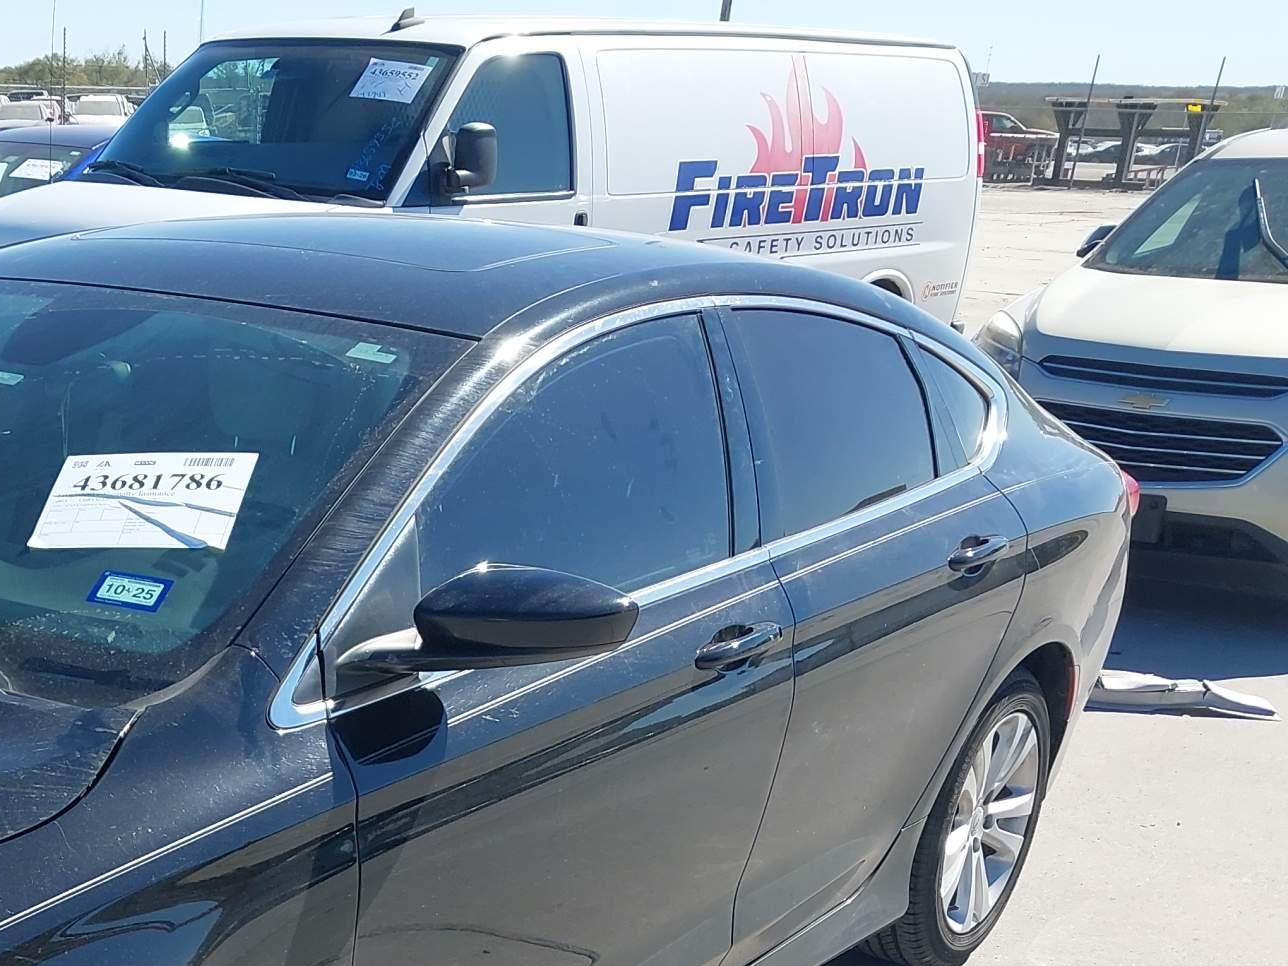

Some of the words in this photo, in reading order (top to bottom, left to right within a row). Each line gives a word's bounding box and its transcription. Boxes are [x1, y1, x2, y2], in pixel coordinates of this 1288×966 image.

[814, 228, 914, 250] SOLUTIONS
[73, 474, 224, 491] 43681786
[106, 583, 126, 596] 10
[132, 587, 156, 601] 25
